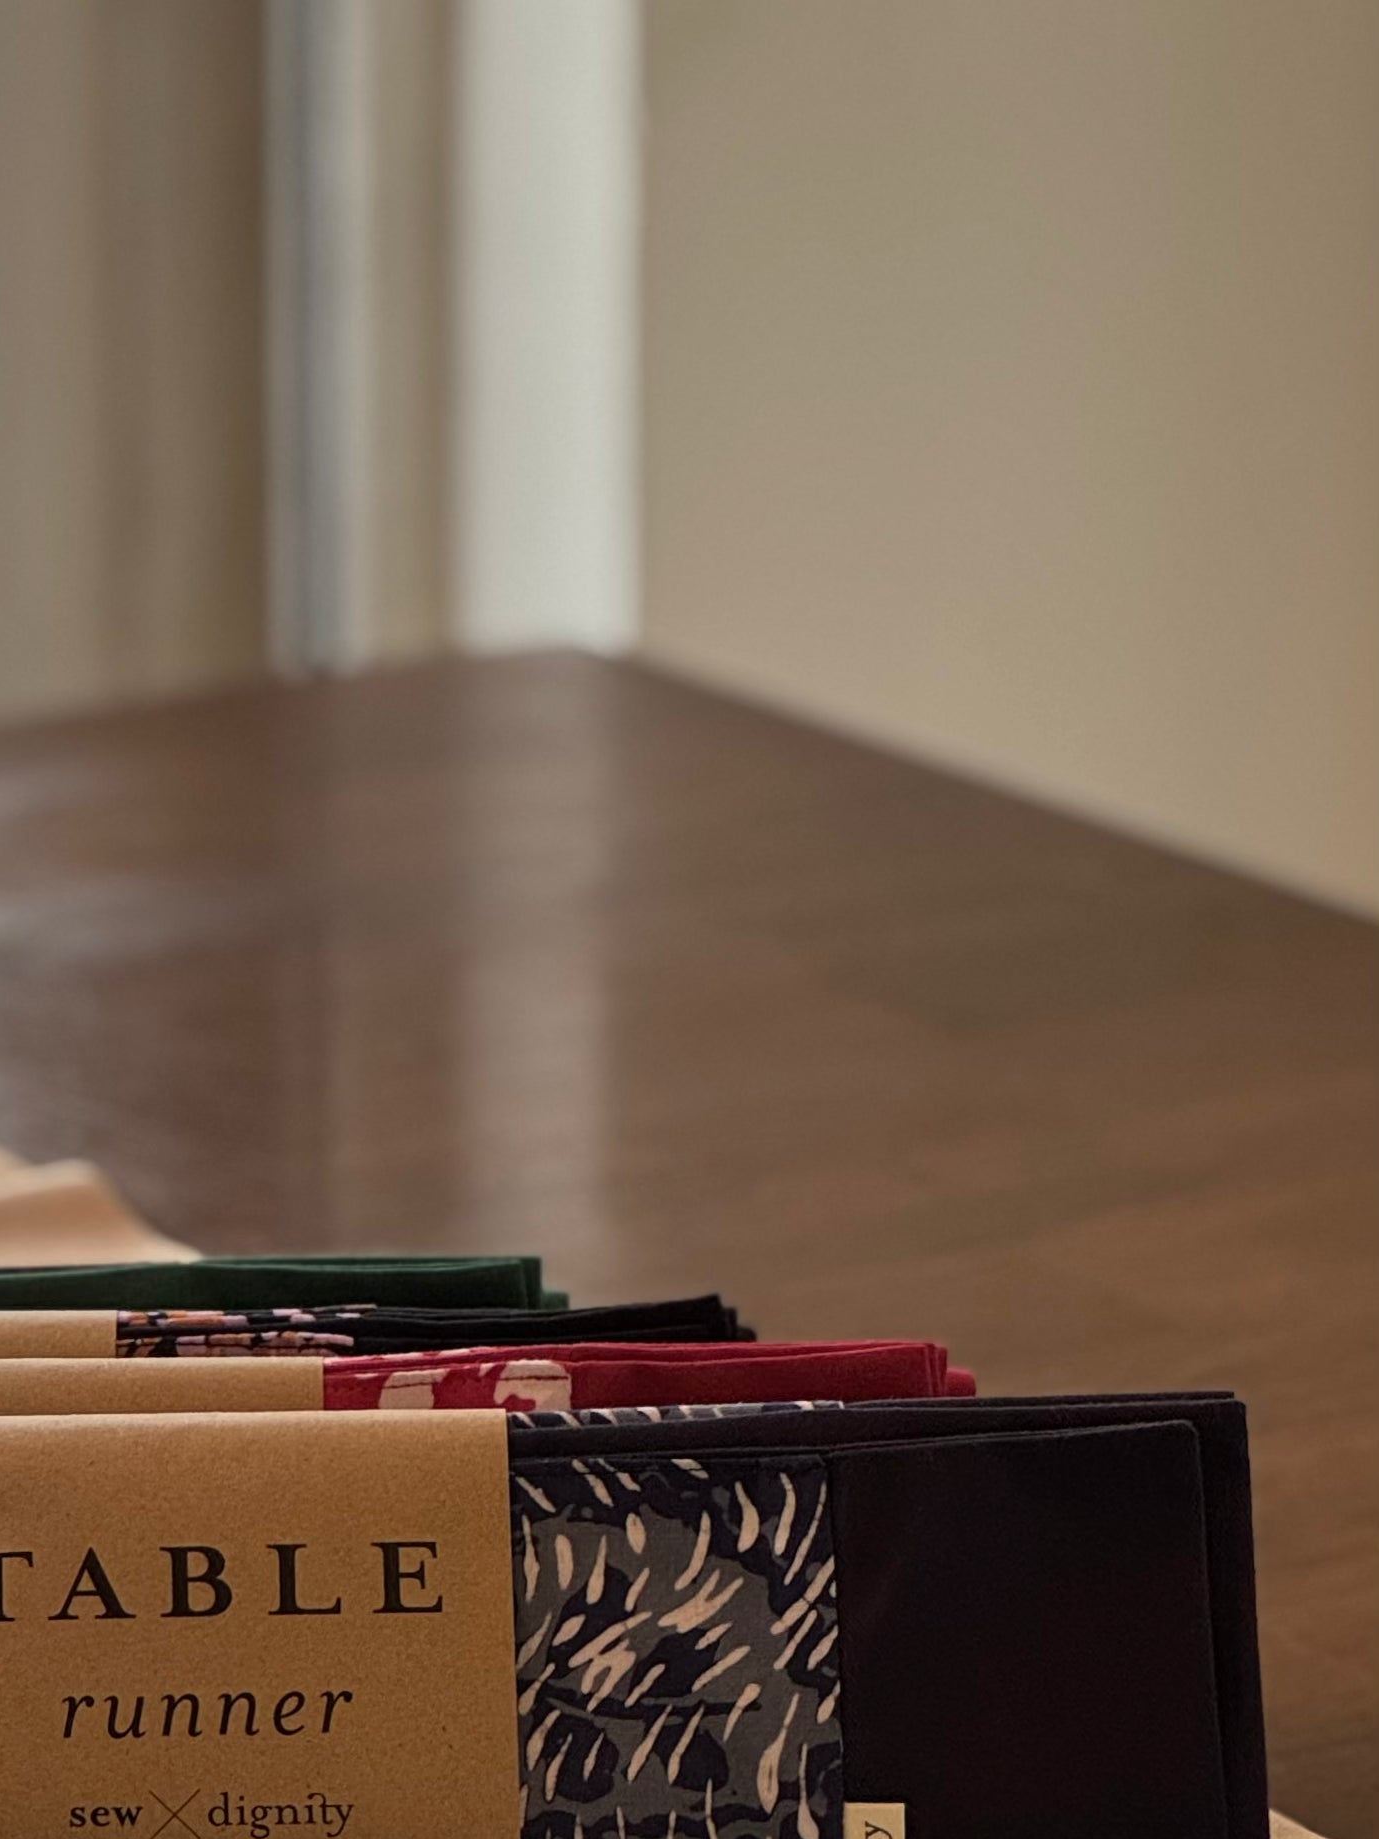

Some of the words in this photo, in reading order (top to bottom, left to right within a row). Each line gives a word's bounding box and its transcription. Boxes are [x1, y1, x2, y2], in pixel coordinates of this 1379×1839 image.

[61, 1690, 355, 1740] runner
[68, 1804, 144, 1829] sew
[207, 1791, 356, 1839] dignity
